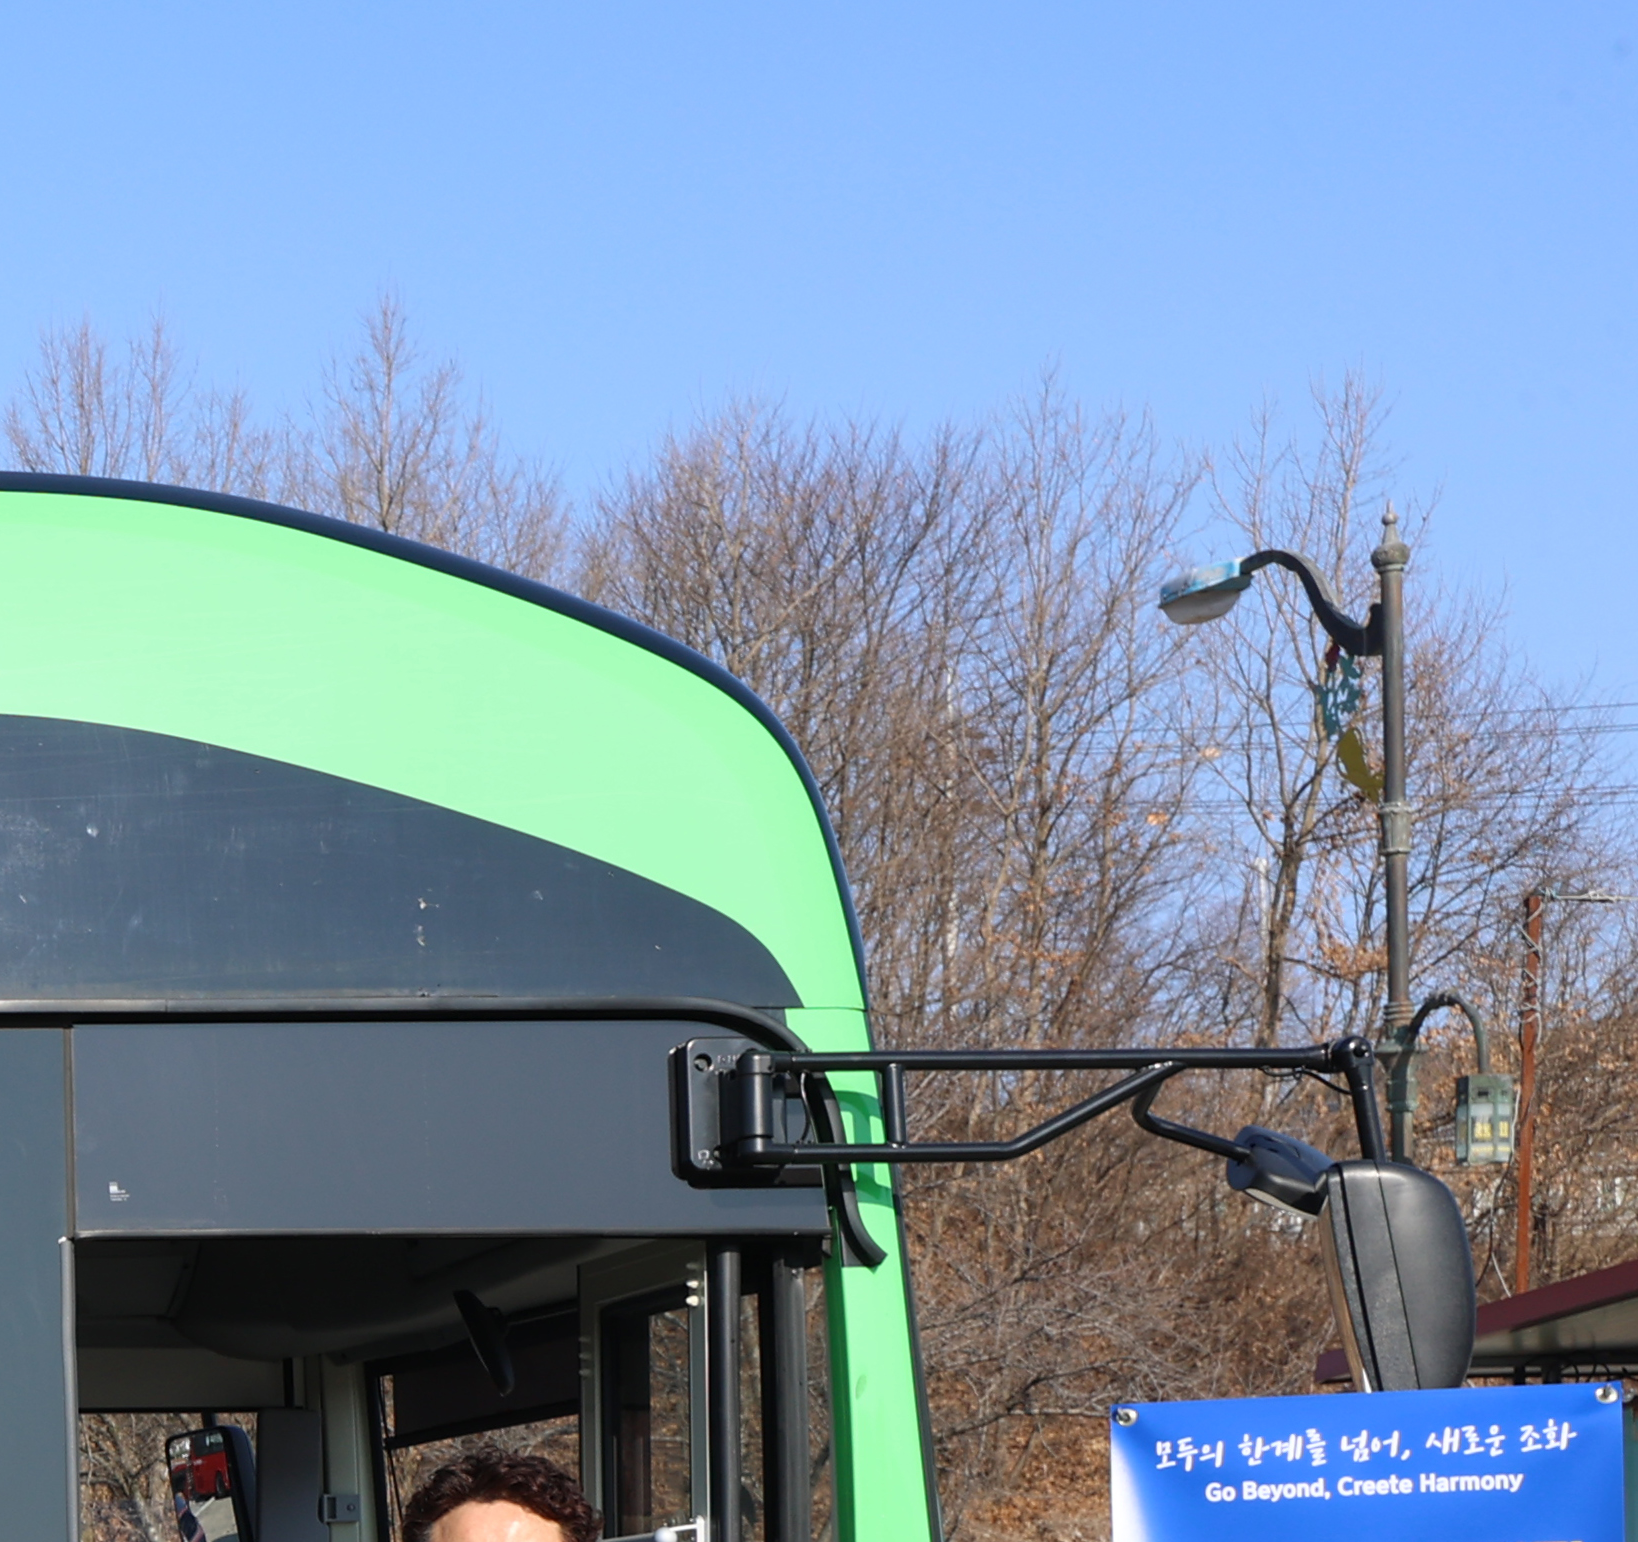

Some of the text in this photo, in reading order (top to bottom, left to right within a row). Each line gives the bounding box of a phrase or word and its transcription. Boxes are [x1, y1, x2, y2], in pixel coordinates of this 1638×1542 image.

[1156, 1418, 1578, 1472] 모두의 한계를 넘어, 새로운 조화
[1204, 1482, 1237, 1502] Go
[1242, 1477, 1332, 1502] Beyond,
[1419, 1472, 1525, 1493] Harmony
